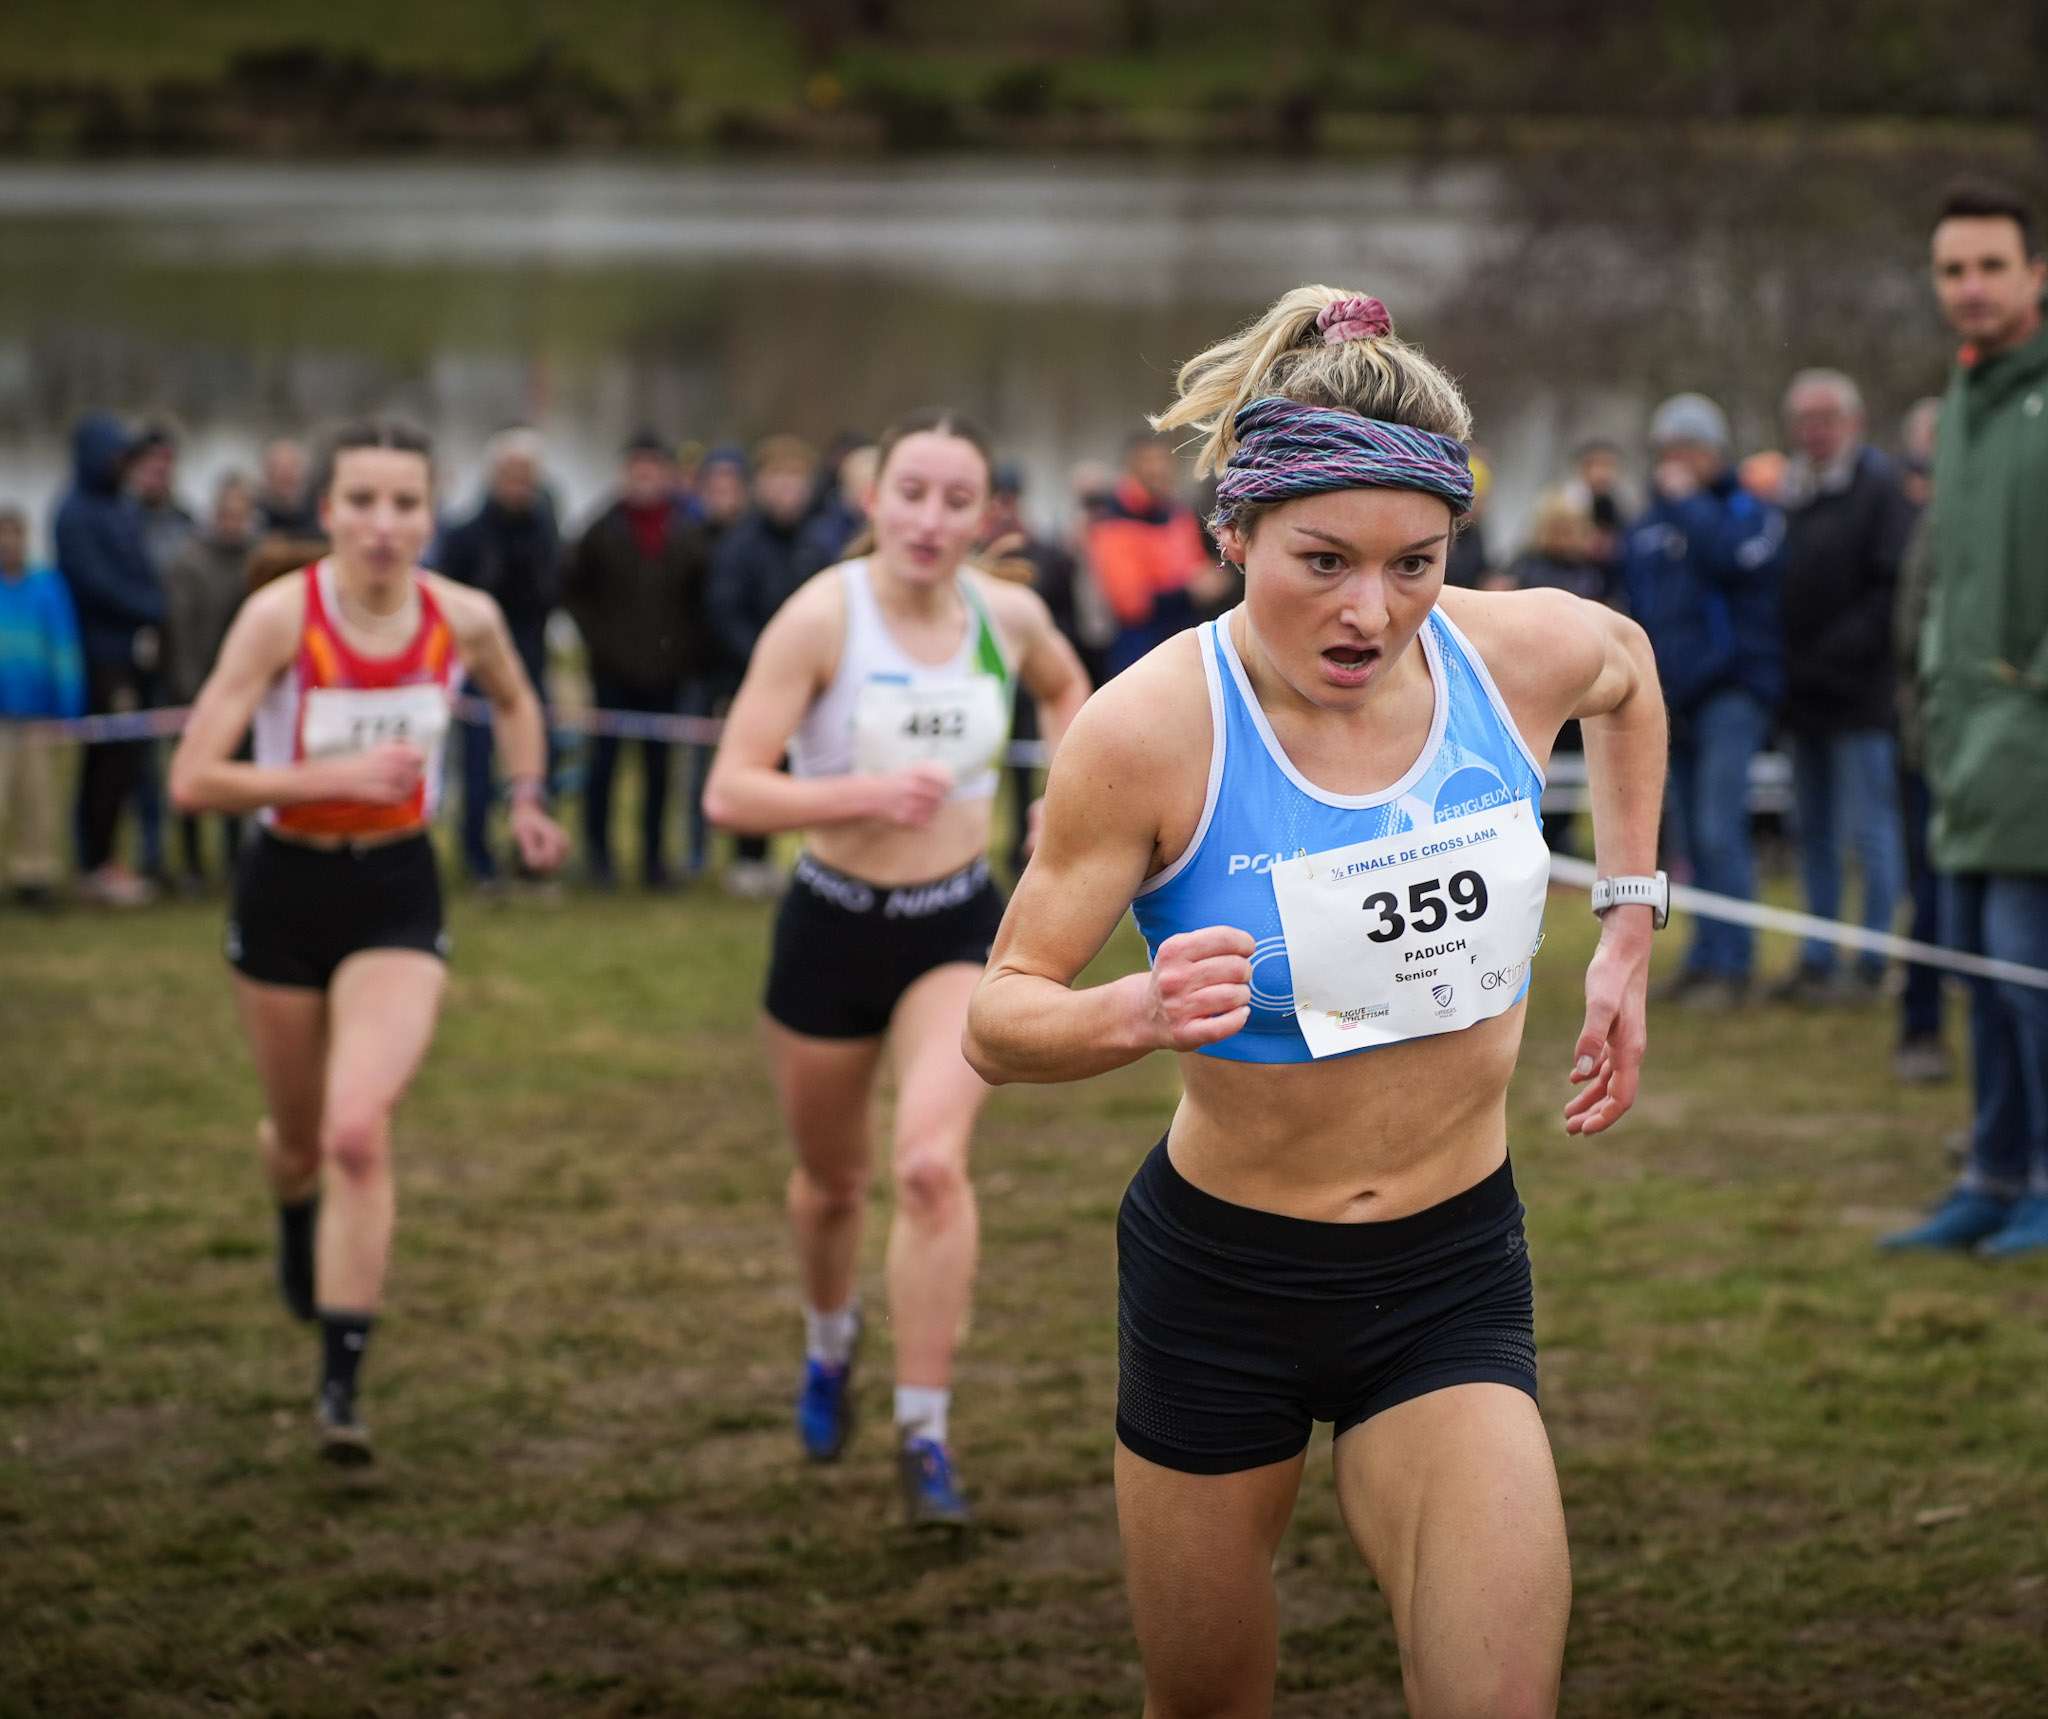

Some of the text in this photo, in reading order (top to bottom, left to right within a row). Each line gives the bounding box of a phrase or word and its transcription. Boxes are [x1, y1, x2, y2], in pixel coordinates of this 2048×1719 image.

[1347, 854, 1395, 875] FINALE
[1400, 849, 1418, 862] DE
[1422, 837, 1464, 858] CROSS
[1467, 827, 1498, 846] LANA
[1362, 870, 1488, 943] 359
[1395, 954, 1477, 983] Senior F
[1405, 939, 1467, 963] PADUCH
